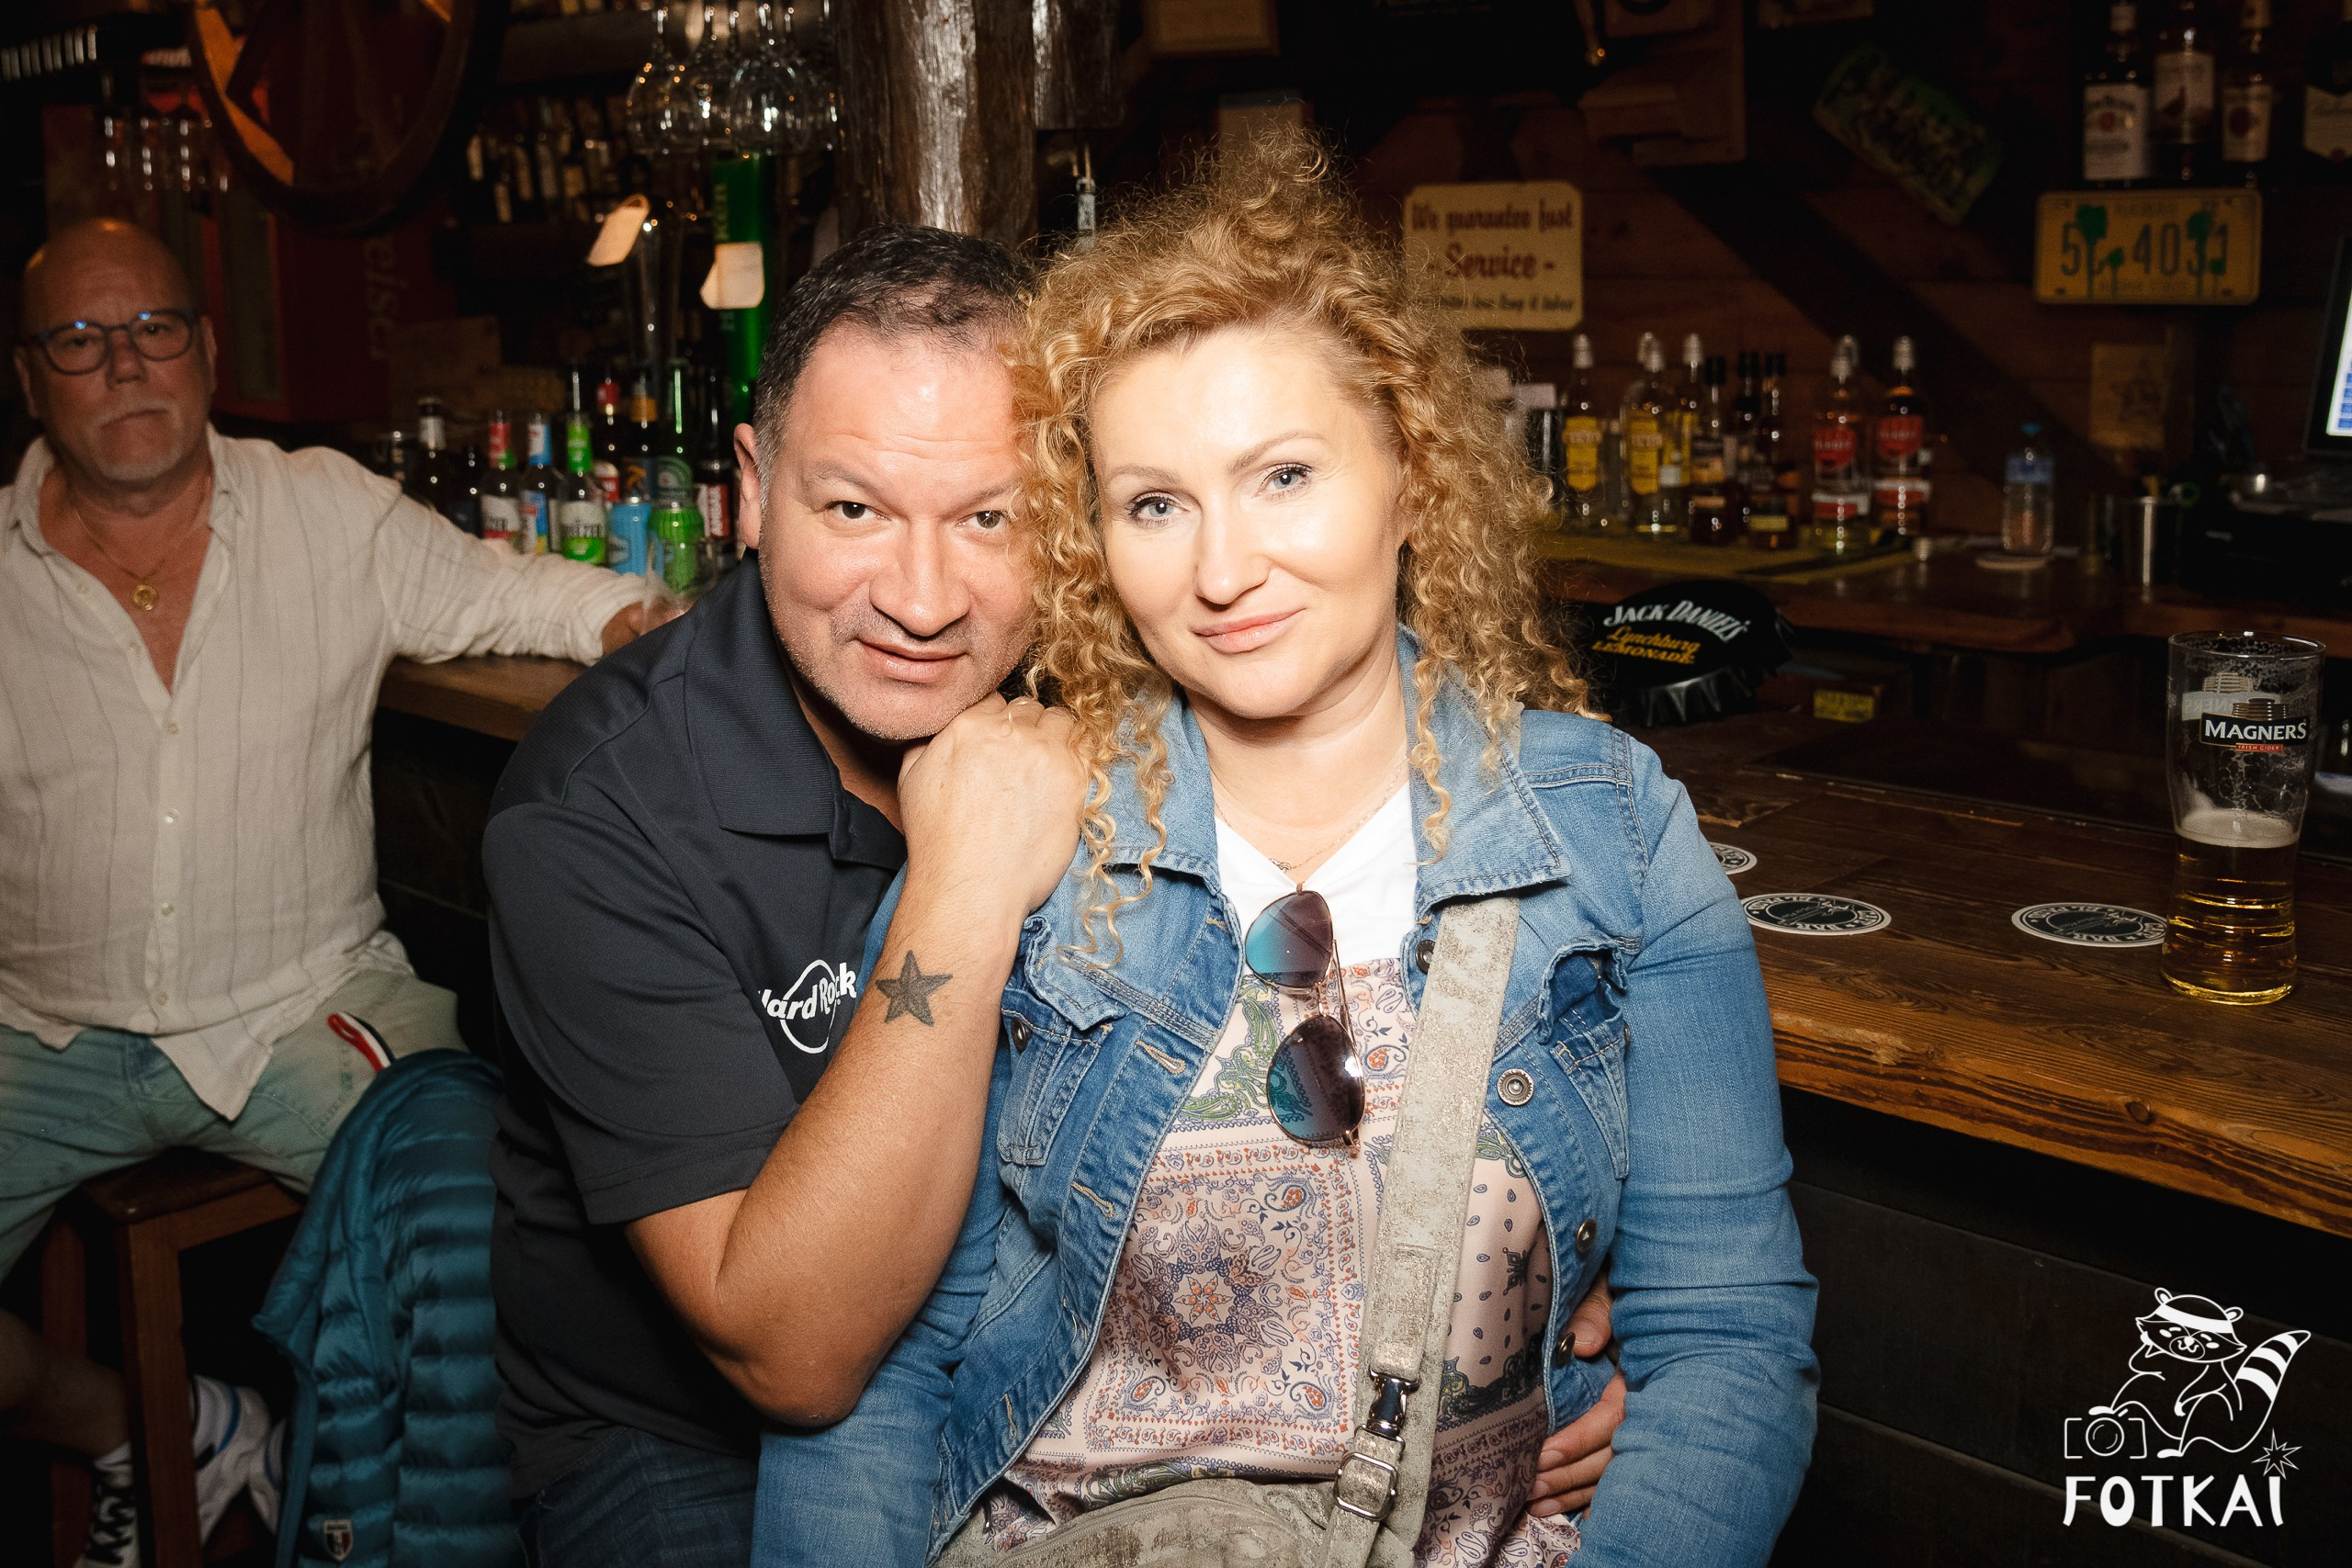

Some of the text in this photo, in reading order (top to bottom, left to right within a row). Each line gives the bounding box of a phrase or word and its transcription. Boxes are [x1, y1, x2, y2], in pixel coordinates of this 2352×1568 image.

[1412, 197, 1574, 236] We guarantee fast
[1444, 243, 1536, 279] Service
[1603, 604, 1669, 626] JACK
[1591, 640, 1694, 664] LEMONADE
[1607, 626, 1701, 653] Lynchburg
[2205, 720, 2307, 740] MAGNERS
